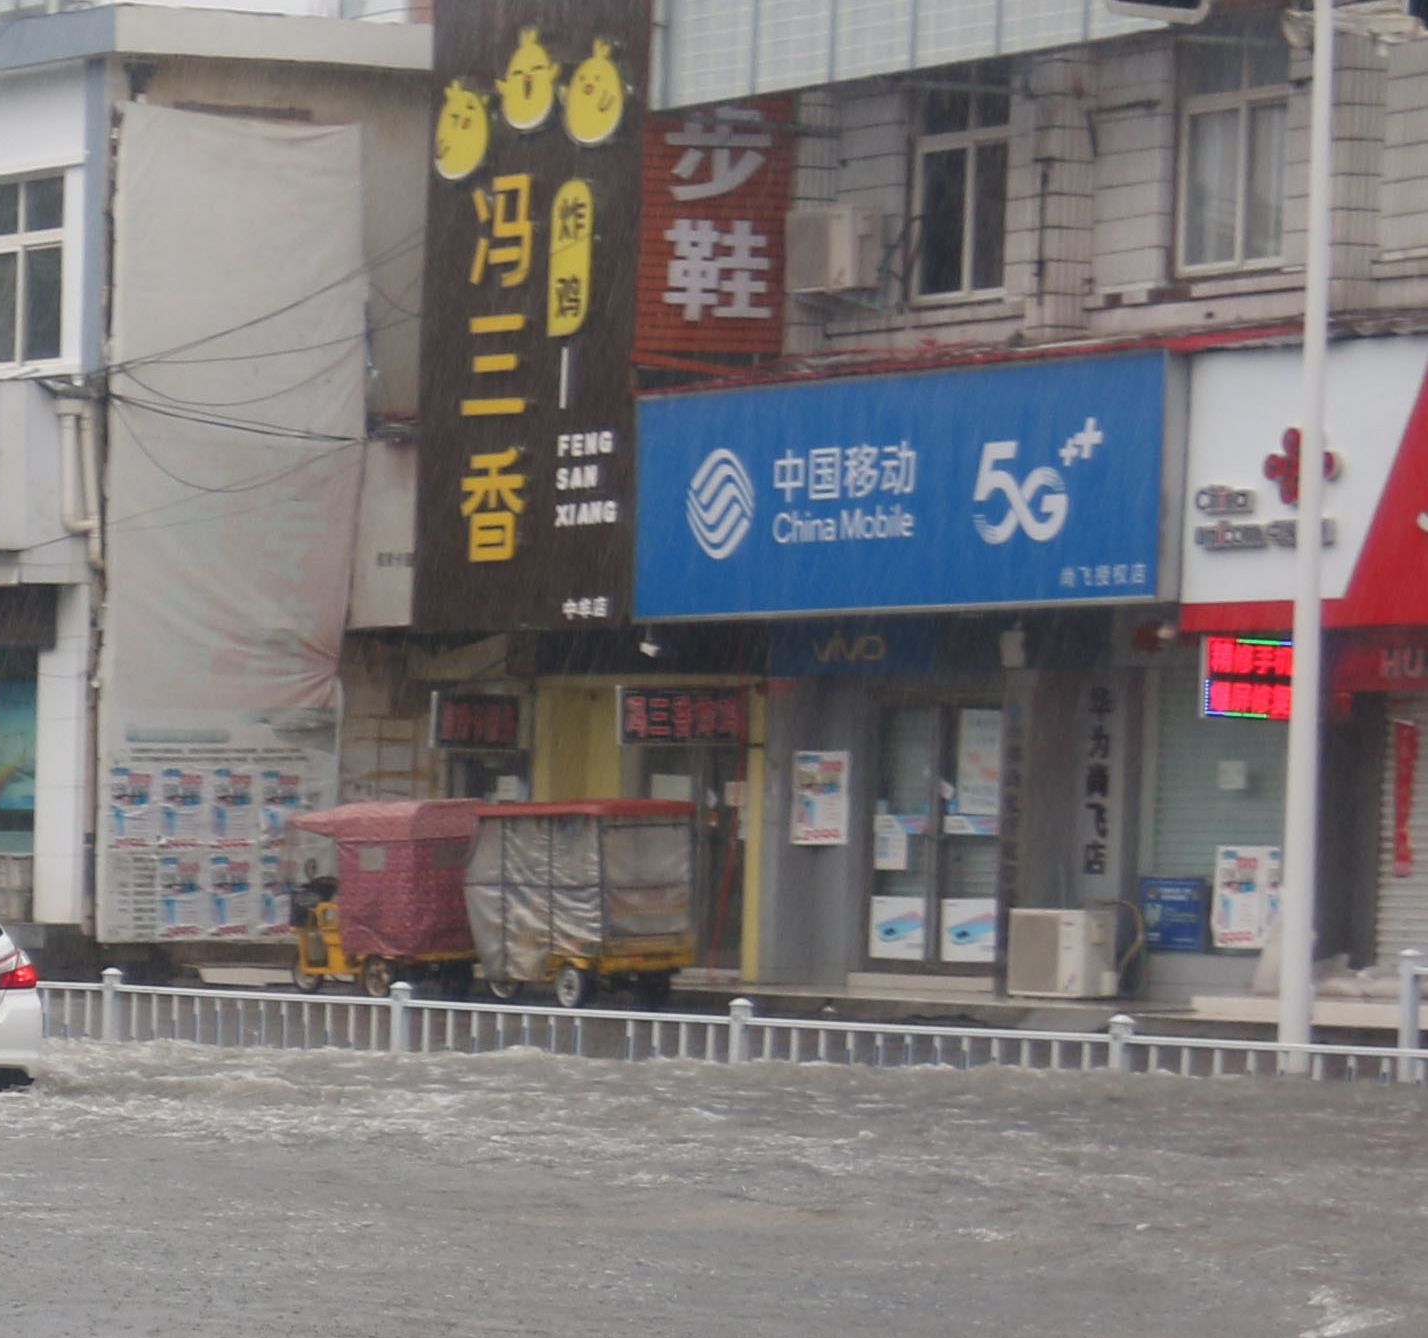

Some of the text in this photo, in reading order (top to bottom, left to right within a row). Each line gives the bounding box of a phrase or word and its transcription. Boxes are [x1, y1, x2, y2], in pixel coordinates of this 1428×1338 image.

[461, 174, 533, 562] 冯三香
[557, 431, 614, 457] FENG
[555, 465, 598, 490] SAN
[772, 440, 917, 502] 中国移动
[554, 500, 618, 527] XIANG
[772, 503, 915, 544] China Mobile
